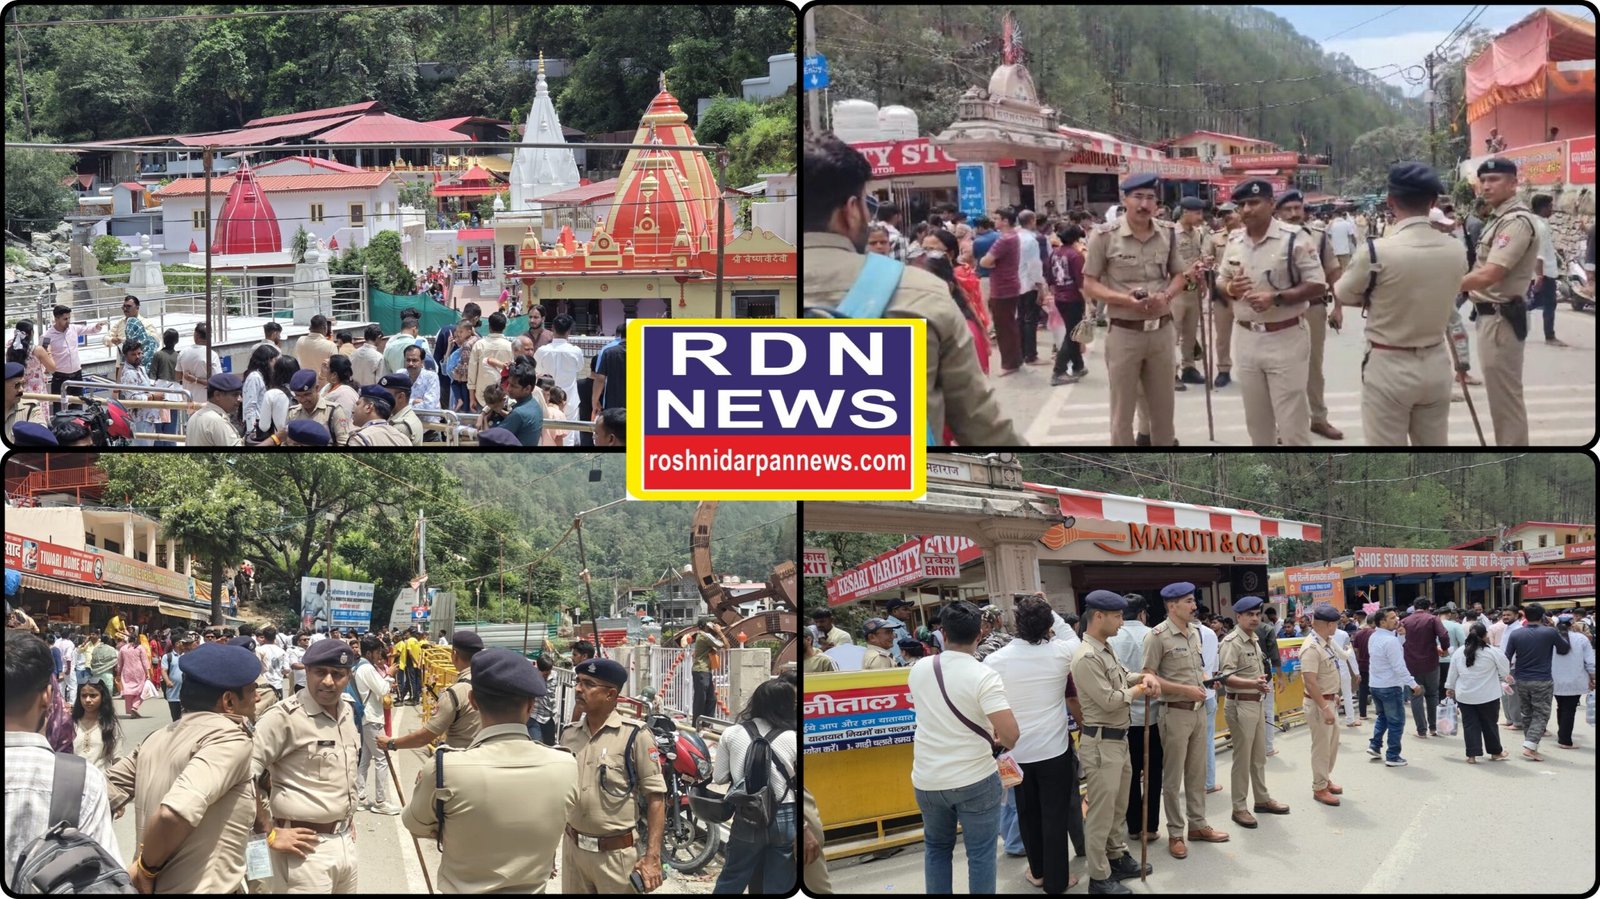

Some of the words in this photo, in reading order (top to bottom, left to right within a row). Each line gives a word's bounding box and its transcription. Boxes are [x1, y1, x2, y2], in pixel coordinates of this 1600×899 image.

[1128, 523, 1218, 553] MARUTI
[1220, 533, 1235, 553] &
[1236, 532, 1266, 554] CO.
[40, 550, 62, 567] TIWARI
[63, 555, 80, 571] HOME
[80, 559, 94, 574] STAY
[923, 553, 955, 565] प्रवेश
[1359, 552, 1381, 568] SHOE
[1384, 553, 1409, 568] STAND
[1411, 554, 1429, 568] FREE
[1431, 555, 1458, 568] SERVICE
[837, 568, 870, 596] KESARI
[869, 543, 921, 585] VARIETY
[925, 565, 956, 576] ENTRY
[820, 722, 838, 730] आप
[842, 719, 858, 728] और
[878, 715, 914, 723] यातायात
[808, 733, 844, 742] यातायात
[846, 728, 873, 738] नियमों
[888, 725, 910, 733] पालन
